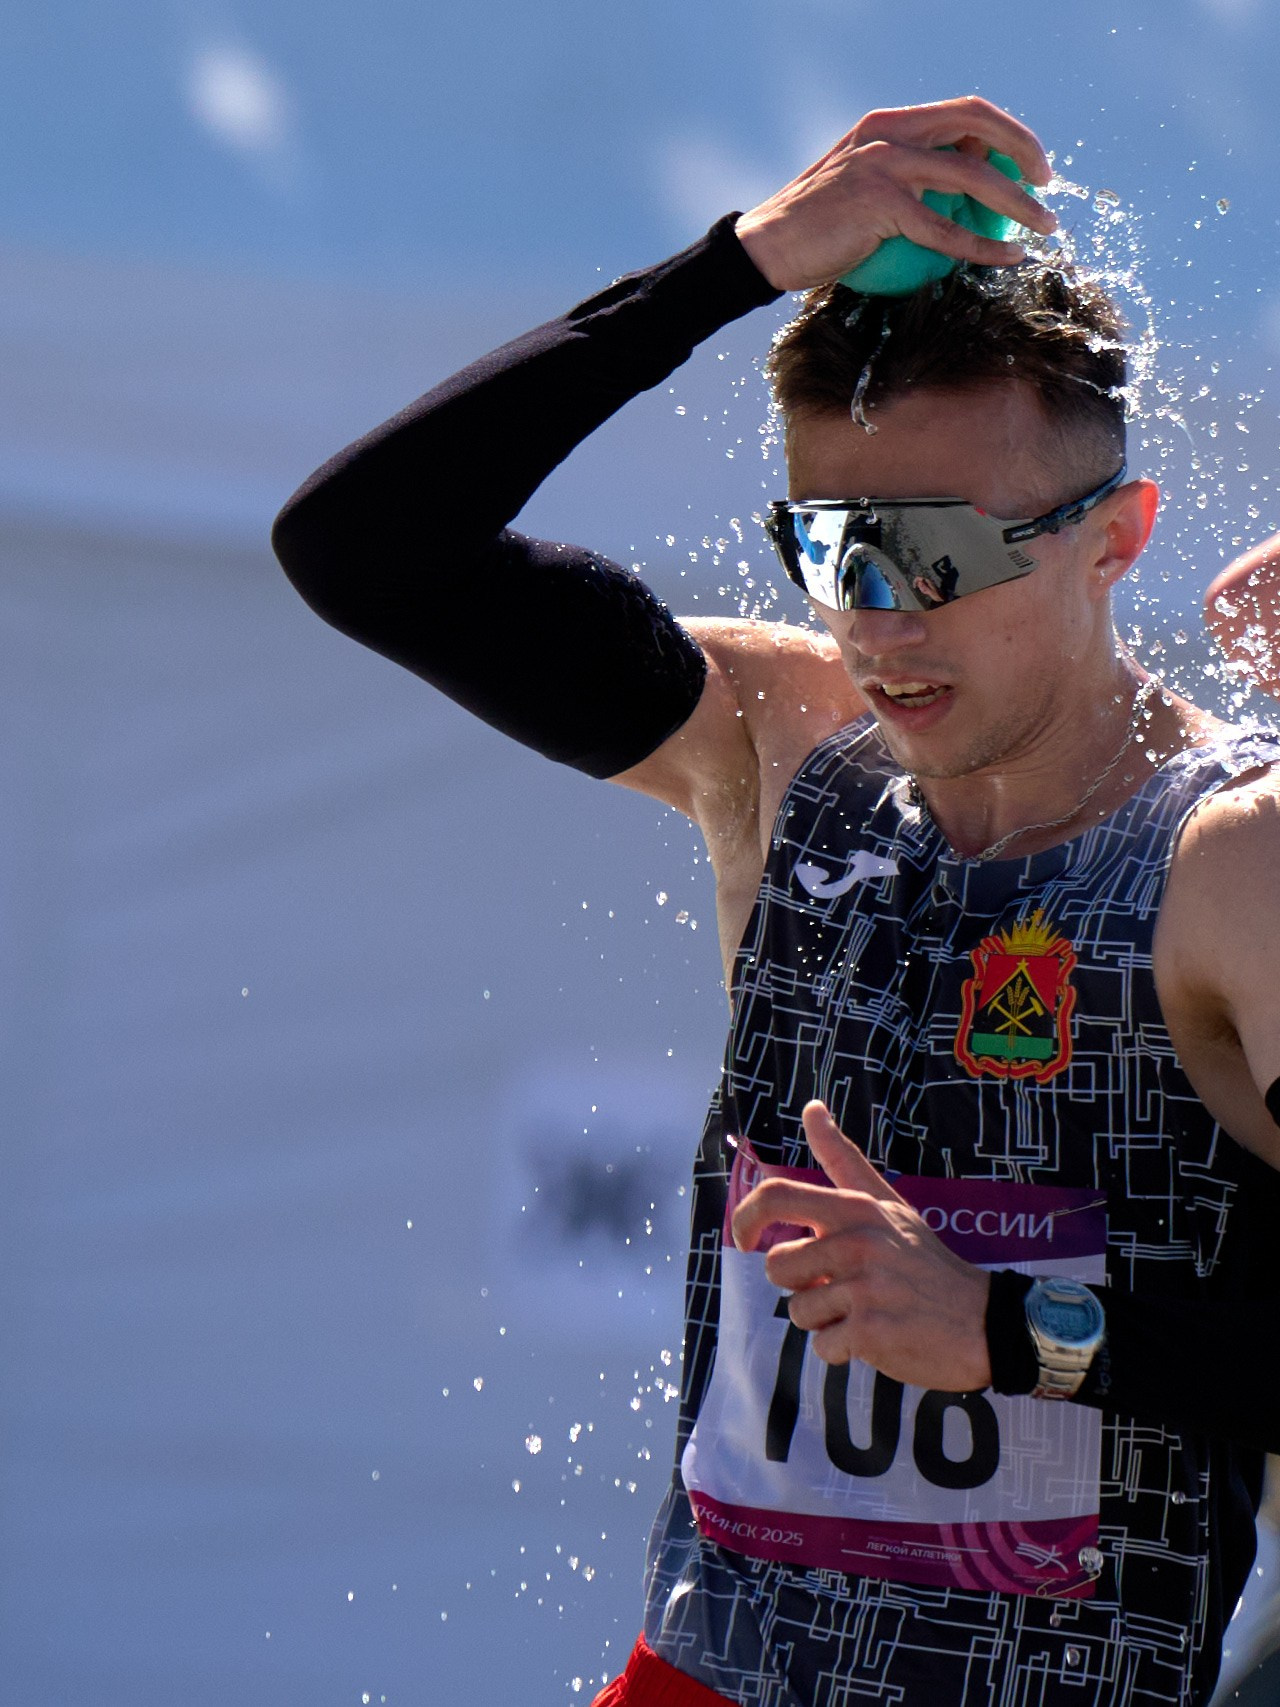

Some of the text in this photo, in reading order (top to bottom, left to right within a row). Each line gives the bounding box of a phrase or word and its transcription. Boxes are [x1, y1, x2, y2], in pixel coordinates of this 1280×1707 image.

[920, 1206, 1054, 1241] ОССИИ
[761, 1526, 804, 1547] 2025
[866, 1541, 908, 1556] ЛЕГКОЙ
